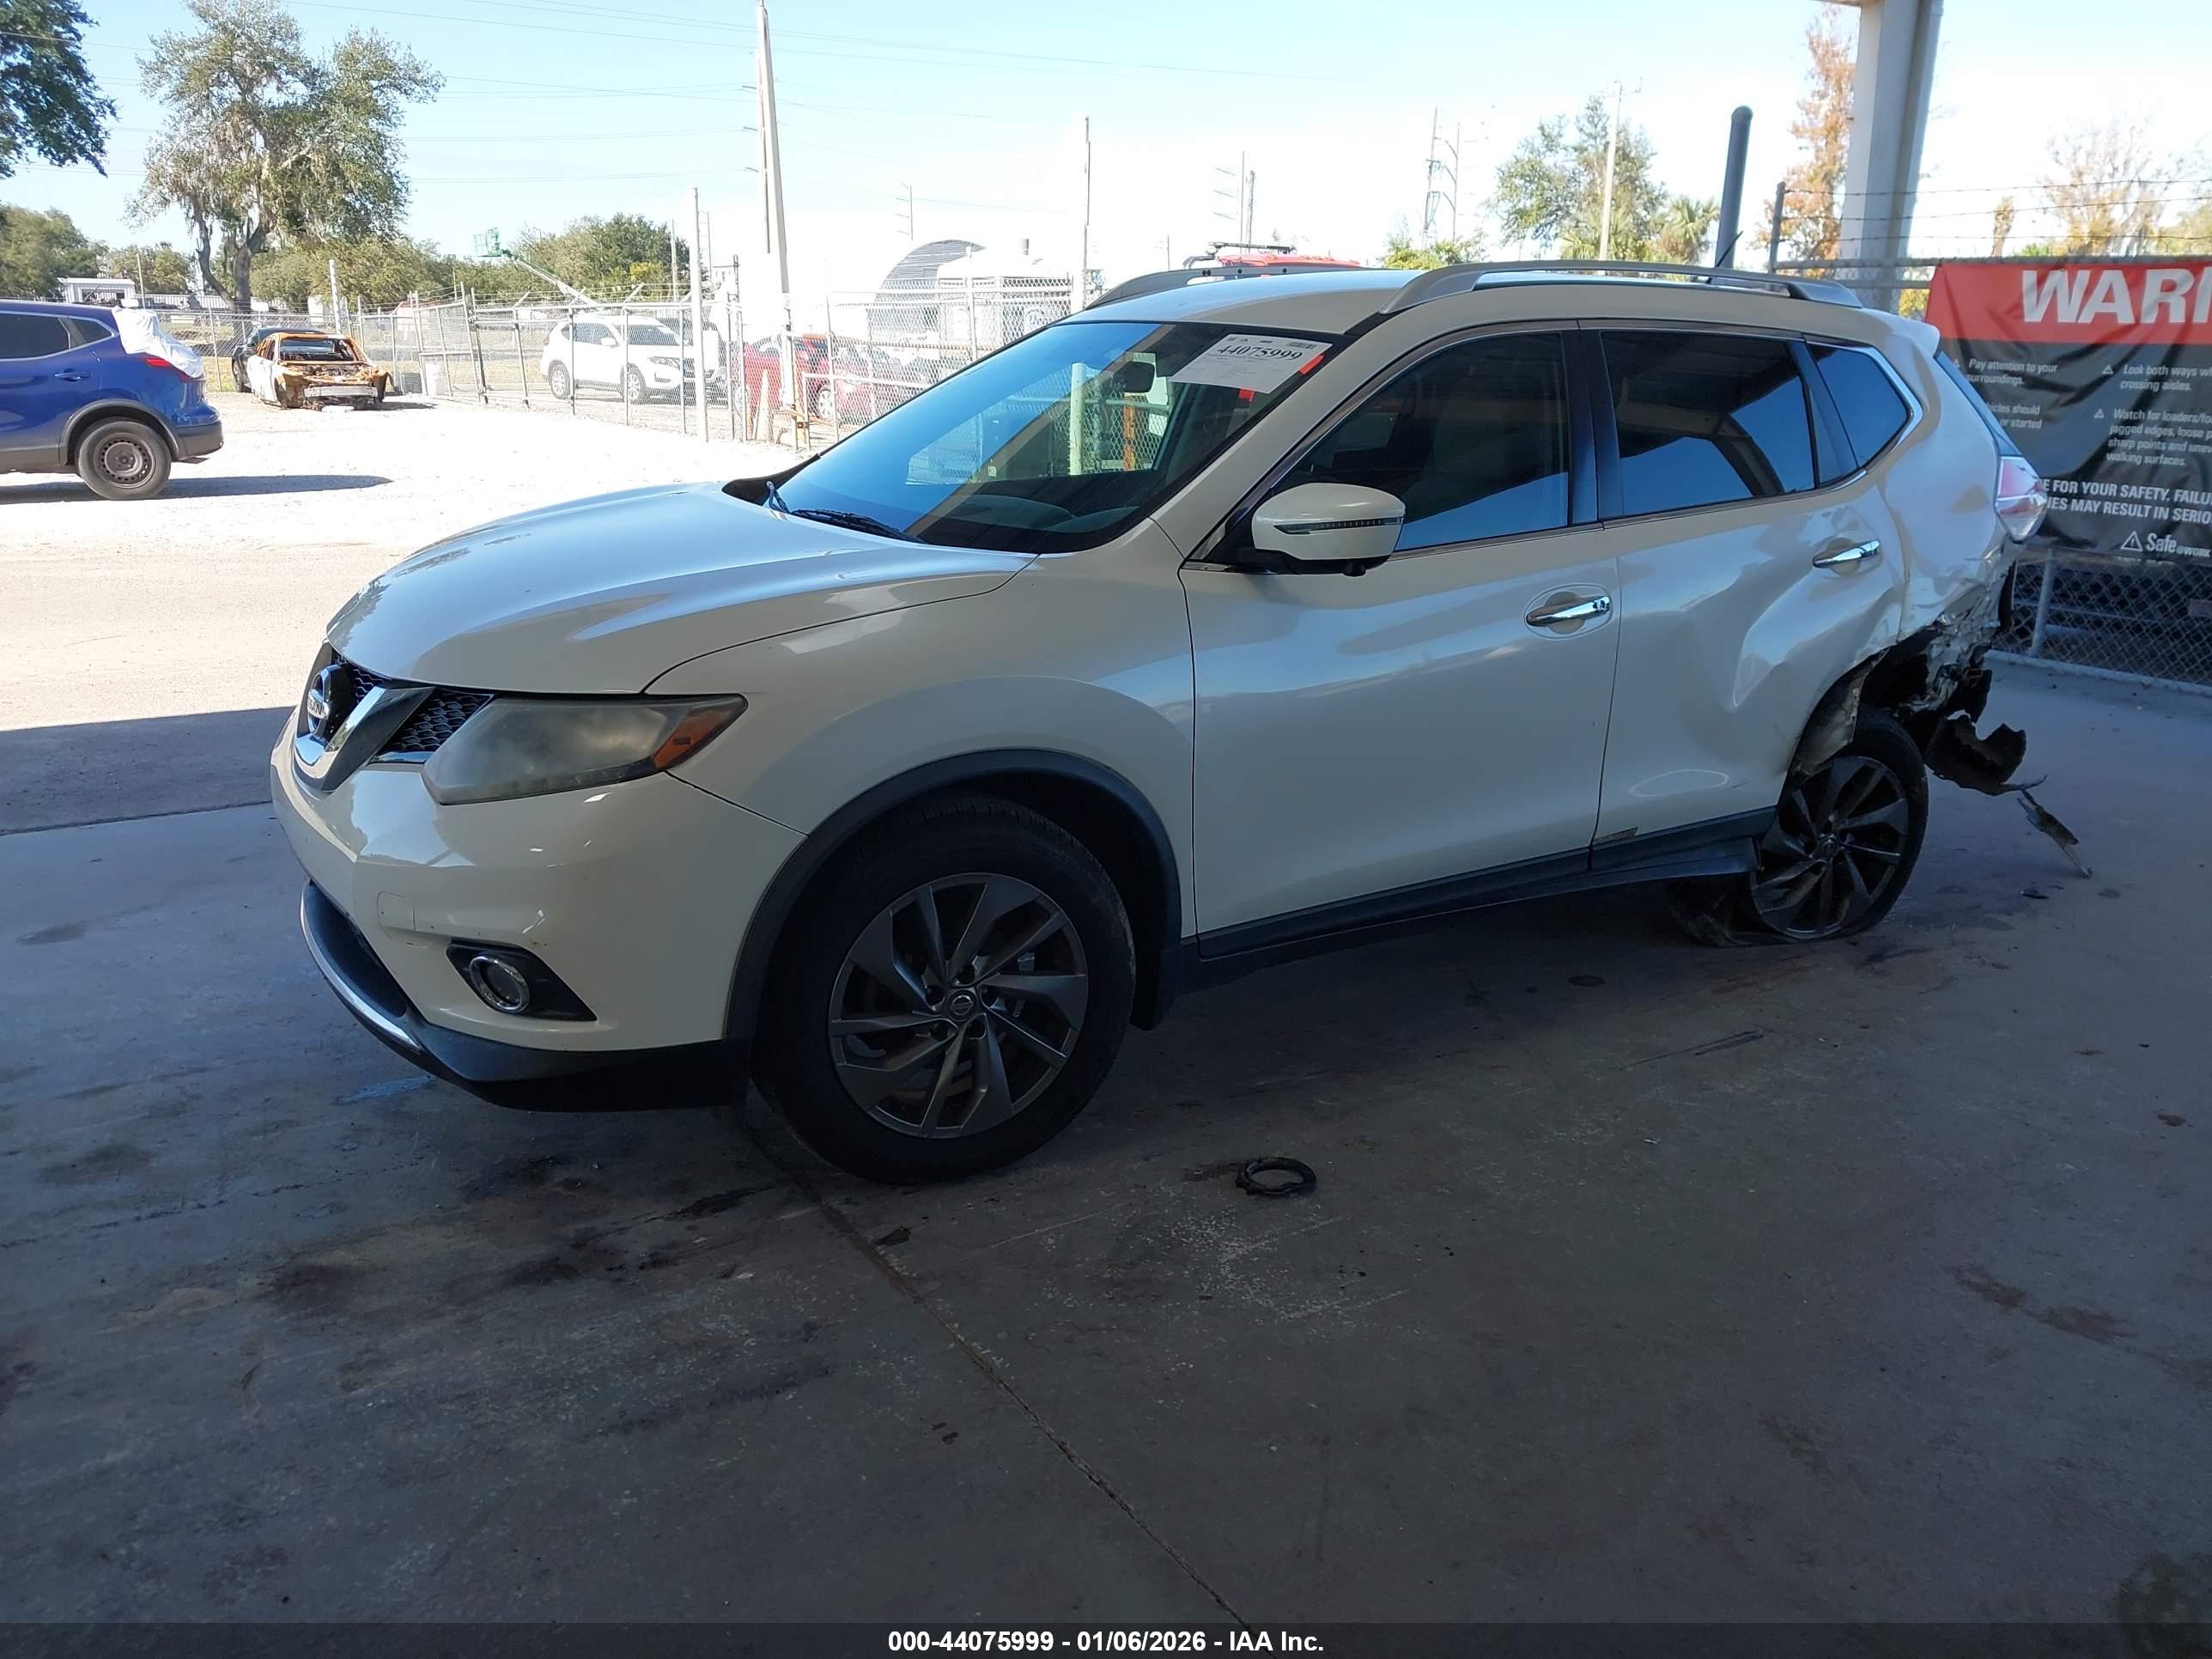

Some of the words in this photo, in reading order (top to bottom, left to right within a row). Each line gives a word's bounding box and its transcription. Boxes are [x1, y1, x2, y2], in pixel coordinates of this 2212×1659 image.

[1217, 344, 1303, 361] 44075999
[1969, 358, 1985, 372] Pay
[1987, 361, 2025, 372] attention
[2027, 362, 2036, 372] to
[2038, 364, 2059, 374] your
[2124, 364, 2143, 374] Look
[2146, 365, 2168, 375] both
[2171, 368, 2197, 378] ways
[1966, 374, 2025, 386] surroundings.
[2120, 379, 2160, 392] crossing
[2162, 380, 2191, 391] aisles.
[2013, 404, 2040, 415] should
[2113, 409, 2144, 420] Watch
[2148, 410, 2160, 420] for
[2162, 410, 2212, 424] loaders/fo
[2000, 418, 2008, 427] or
[2010, 418, 2043, 428] started
[2109, 422, 2142, 435] jagged
[2144, 424, 2175, 437] edges,
[2178, 427, 2204, 438] loose
[2107, 438, 2135, 450] sharp
[2136, 440, 2166, 451] points
[2168, 441, 2187, 452] and
[2188, 444, 2212, 454] unev
[2106, 453, 2142, 465] walking
[2144, 453, 2186, 465] surfaces.
[2052, 479, 2078, 494] FOR
[2081, 481, 2118, 496] YOUR
[2120, 483, 2170, 501] SAFETY.
[2173, 489, 2212, 505] FAILU
[2047, 496, 2069, 510] IES
[2070, 498, 2103, 513] MAY
[2103, 501, 2153, 518] RESULT
[2153, 506, 2170, 520] IN
[2172, 507, 2212, 524] SERIO
